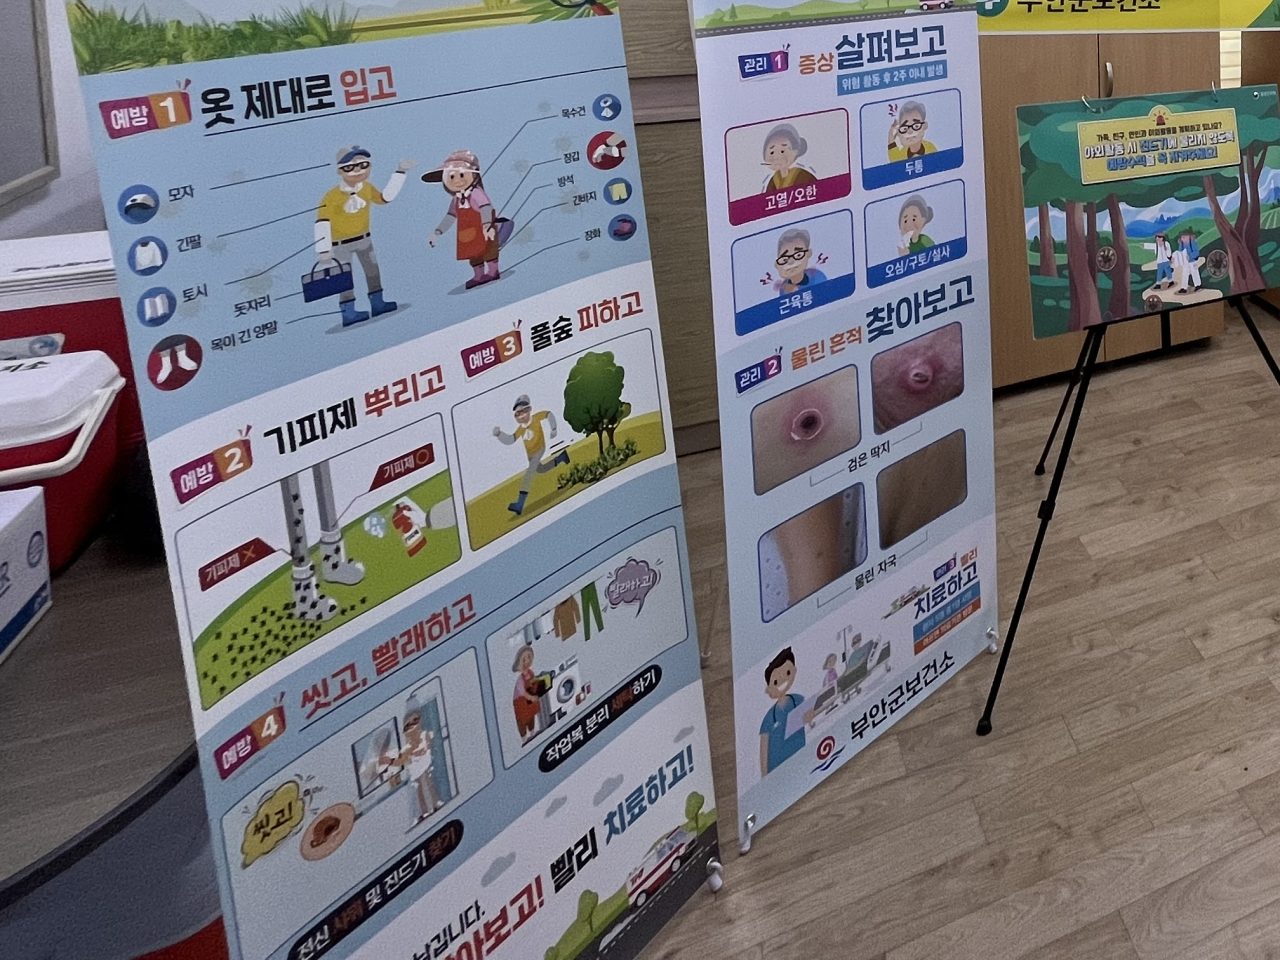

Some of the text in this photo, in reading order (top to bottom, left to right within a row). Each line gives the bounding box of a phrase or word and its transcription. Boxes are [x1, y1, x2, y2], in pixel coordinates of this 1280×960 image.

[744, 25, 947, 75] 관리 1 증상 살펴보고
[893, 70, 907, 82] 2주
[909, 67, 925, 79] 이내
[110, 66, 398, 130] 예방 1 옷 제대로 입고
[563, 151, 580, 164] 장갑
[905, 160, 923, 174] 두통
[169, 185, 195, 202] 모자
[765, 185, 817, 211] 고열/오한
[176, 234, 203, 252] 긴팔
[885, 245, 951, 278] 오심/구토/설사
[183, 283, 208, 303] 토시
[234, 294, 271, 318] 돗자리
[778, 293, 813, 316] 근육통
[211, 320, 278, 351] 목이 긴 양말
[469, 292, 643, 370] 예방 3 풀숲 피하고
[740, 275, 974, 387] 관리 2 물린 흔적 찾아보고
[180, 365, 446, 492] 예방 2 기피제 뿌리고
[384, 454, 415, 478] 기피제
[848, 441, 890, 473] 검은 딱지
[203, 551, 242, 583] 기피제
[854, 554, 897, 590] 물린 자국
[914, 561, 978, 619] 치료하고
[222, 593, 477, 770] 예방 4 씻고, 빨래하고
[851, 650, 955, 740] 부안군보건소
[546, 725, 584, 763] 작업복
[585, 704, 610, 732] 분리
[445, 744, 694, 960] 아보고! 빨리 치료하고!
[365, 886, 383, 911] 및
[384, 849, 427, 895] 진드기
